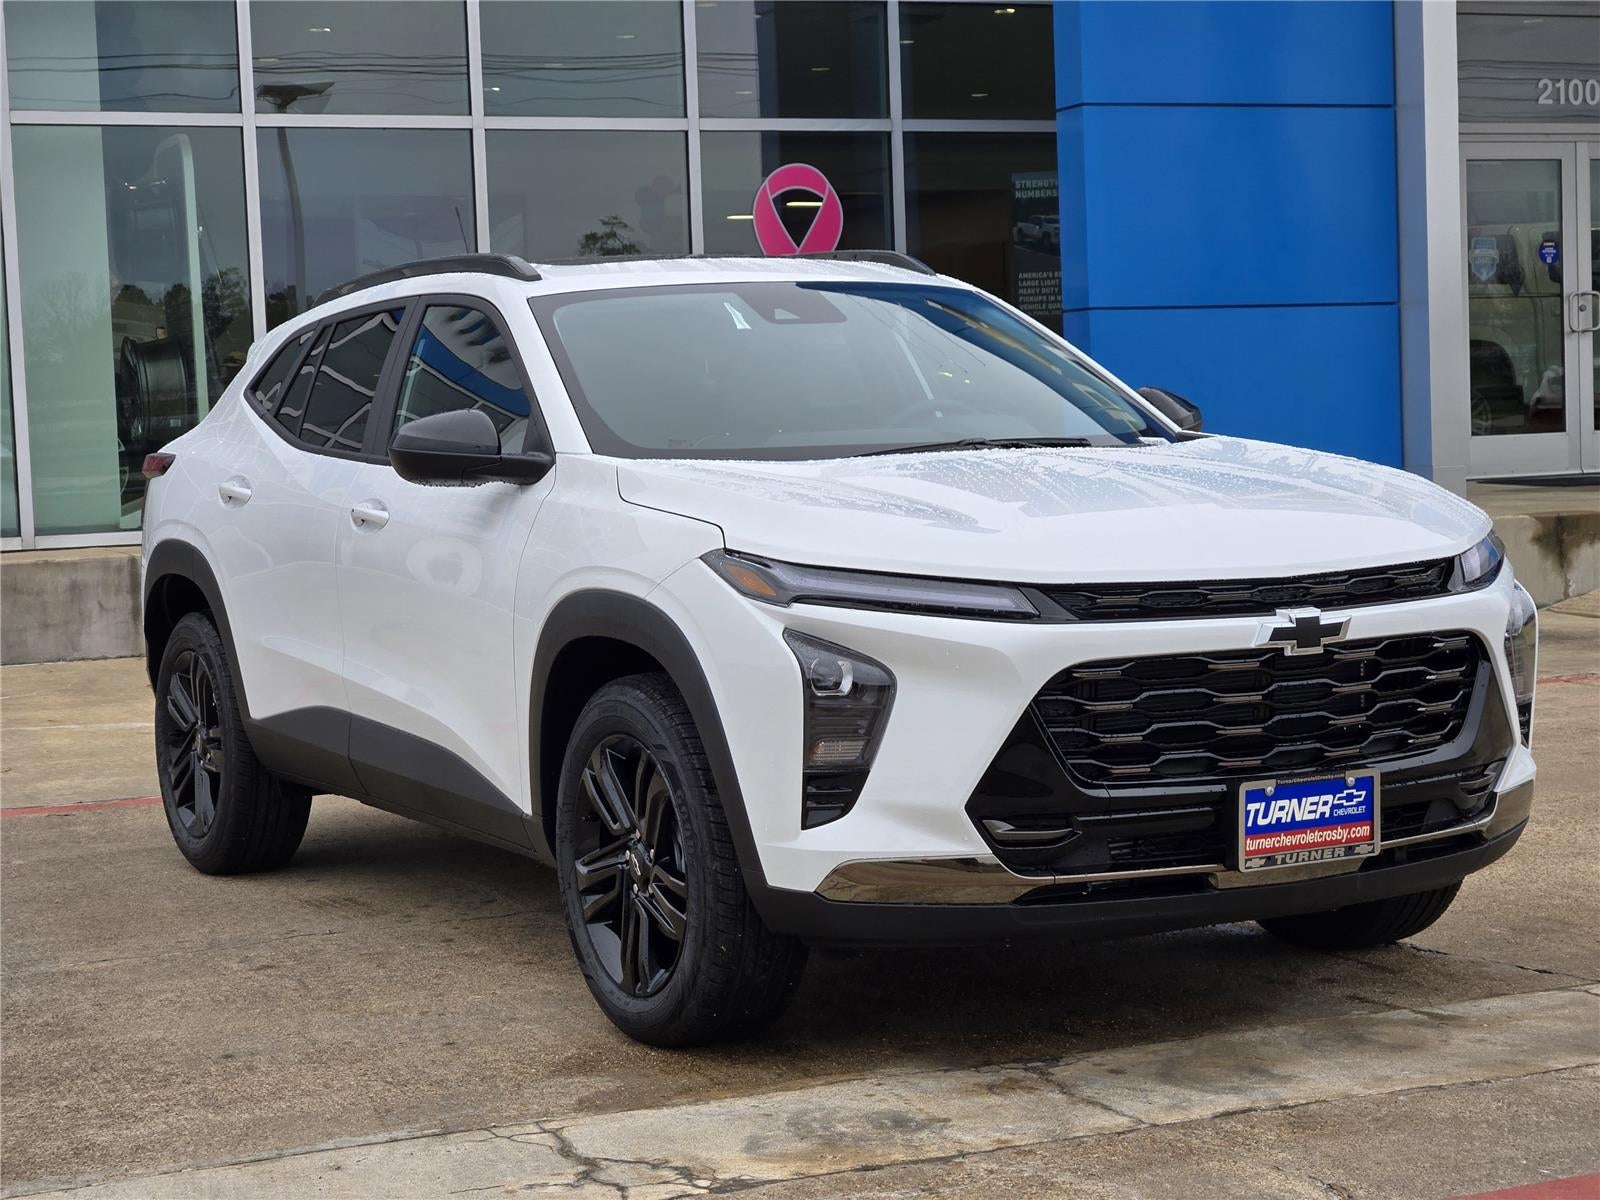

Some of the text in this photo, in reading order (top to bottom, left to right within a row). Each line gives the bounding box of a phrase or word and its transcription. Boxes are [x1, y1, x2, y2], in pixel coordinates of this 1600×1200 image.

[1537, 78, 1600, 106] 2100
[1246, 794, 1334, 827] TURNER
[1333, 805, 1366, 817] CHEVROLET
[1246, 824, 1370, 851] turnerchevroletcrosby.com
[1274, 847, 1345, 865] TURNER
